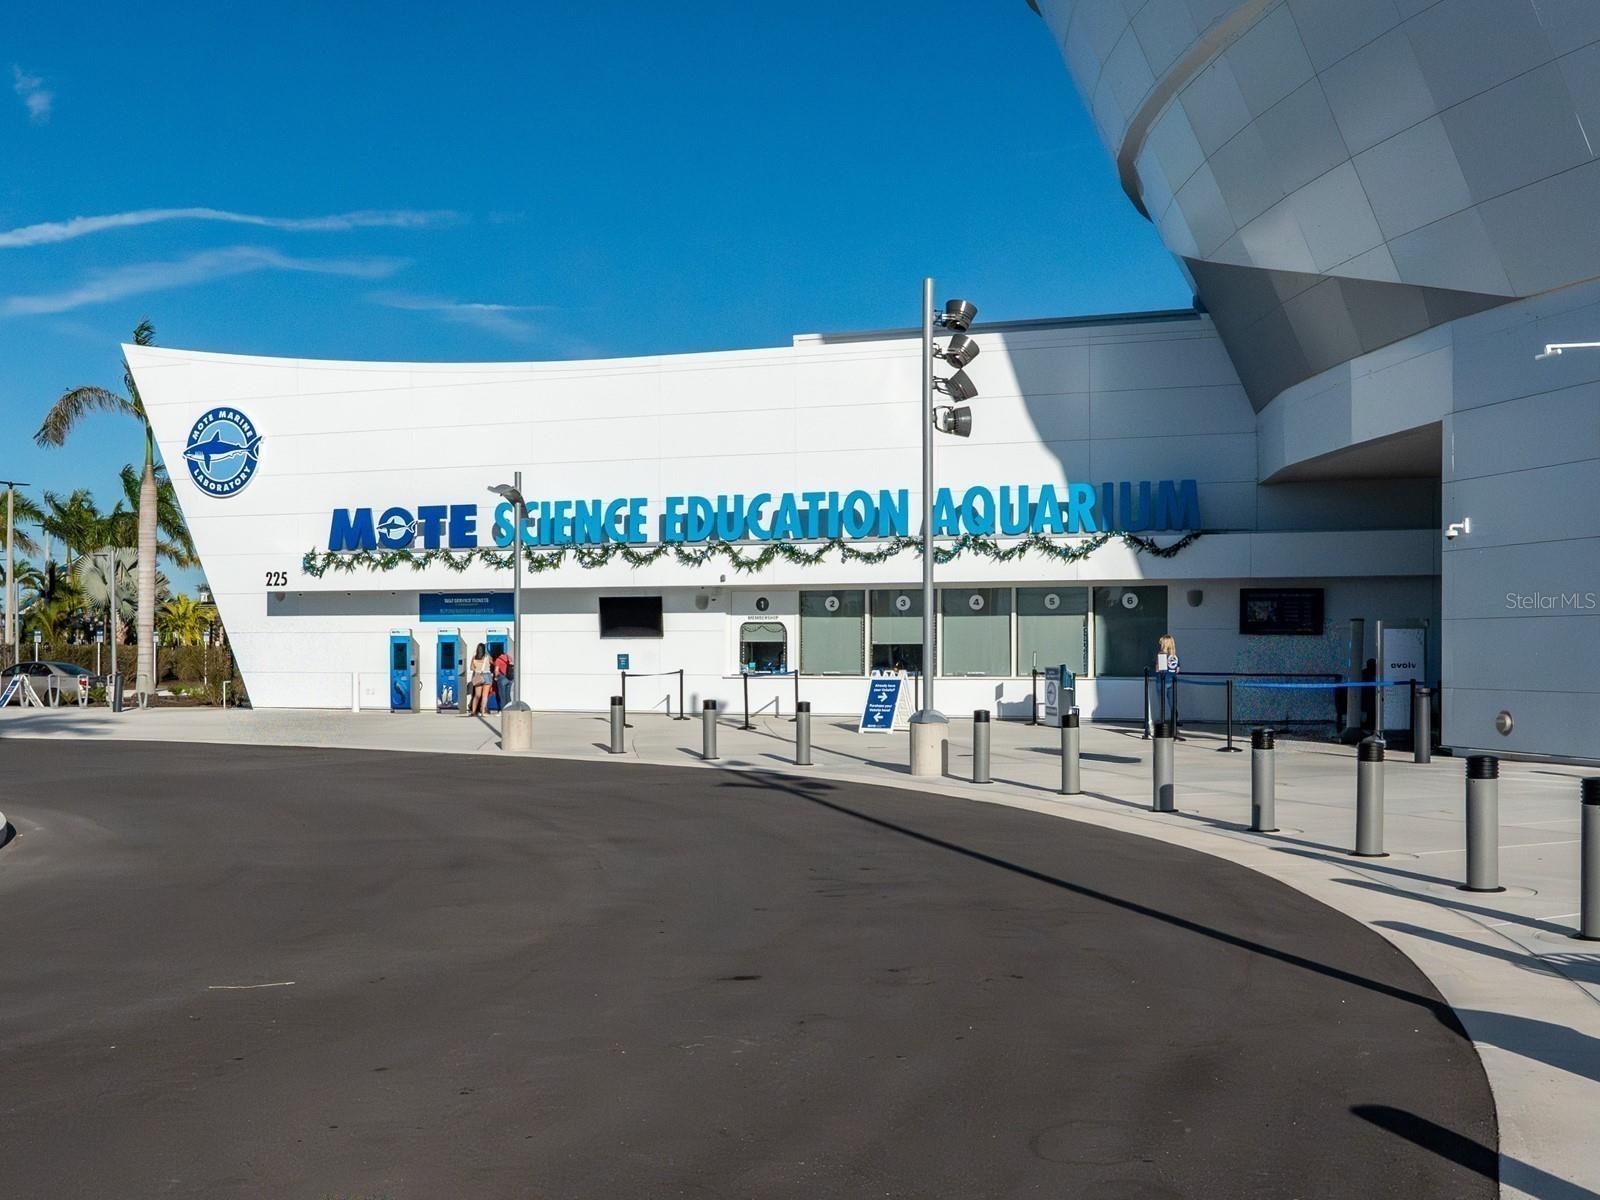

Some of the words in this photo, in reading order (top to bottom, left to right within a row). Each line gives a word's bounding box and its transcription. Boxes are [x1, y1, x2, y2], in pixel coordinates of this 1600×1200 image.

[192, 413, 214, 440] MOTE
[219, 410, 253, 438] MARINE
[193, 465, 251, 492] LABORATORY
[328, 504, 477, 551] MOTE
[494, 497, 648, 547] SCIENCE
[664, 489, 909, 543] EDUCATION
[933, 479, 1201, 536] AQUARIUM
[265, 571, 288, 587] 225
